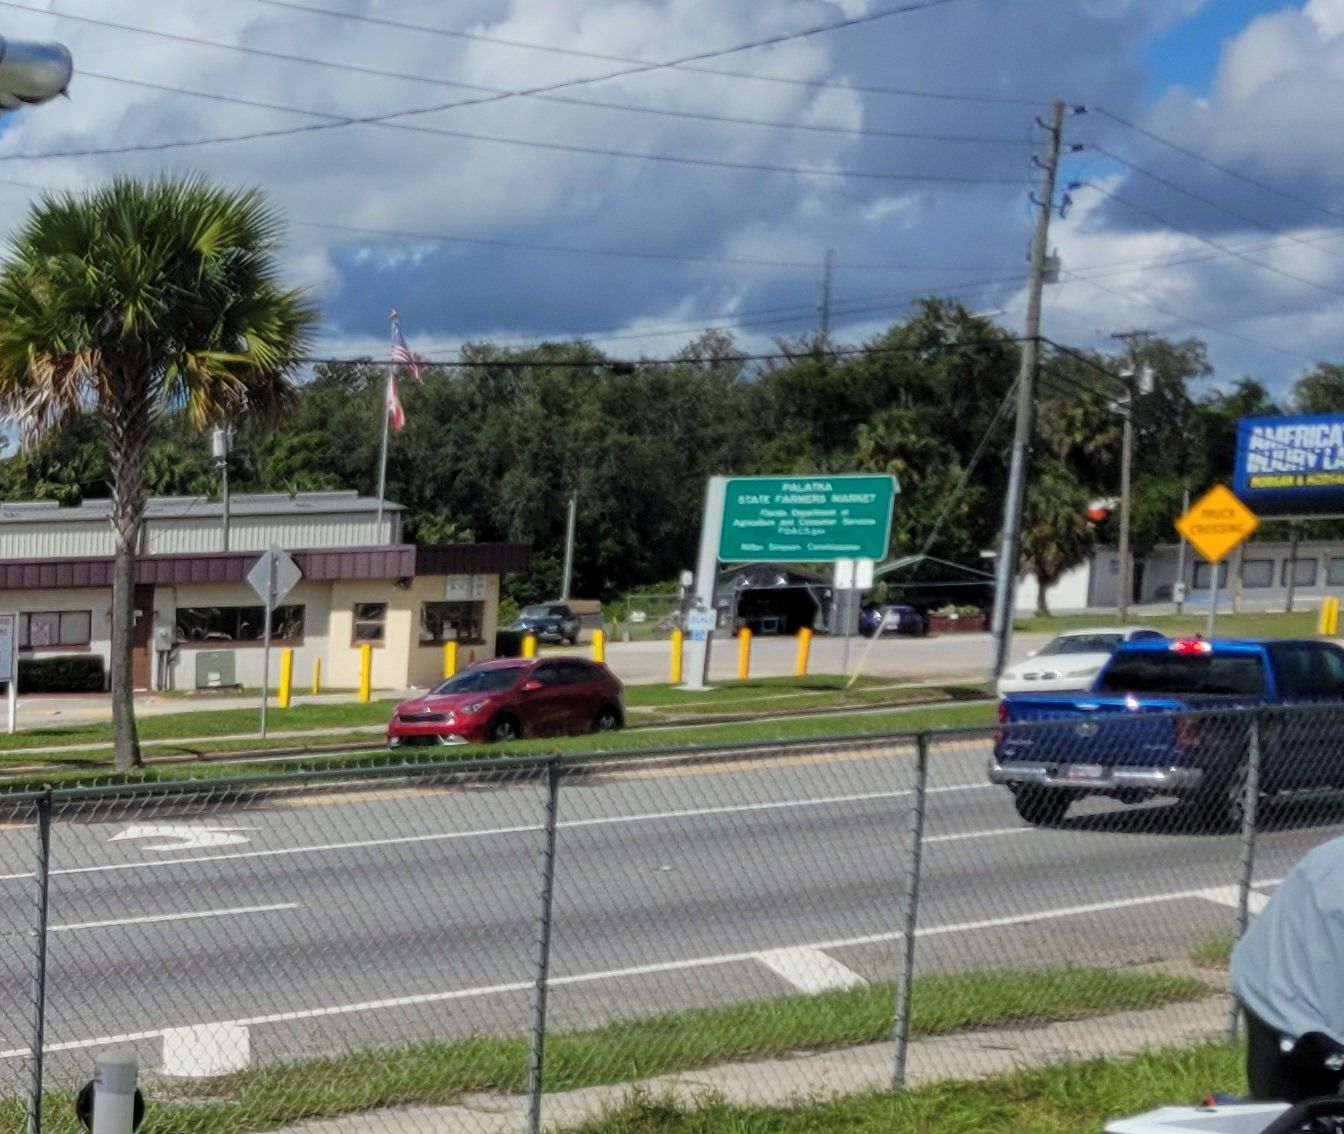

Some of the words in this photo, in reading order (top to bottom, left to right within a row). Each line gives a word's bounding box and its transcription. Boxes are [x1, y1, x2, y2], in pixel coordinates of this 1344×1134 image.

[781, 482, 833, 492] PALATKA
[737, 495, 771, 504] STATE
[774, 494, 827, 504] FARMERS
[830, 493, 877, 503] MARKET
[1201, 508, 1234, 519] TRUCK
[1190, 524, 1243, 536] CROSSING
